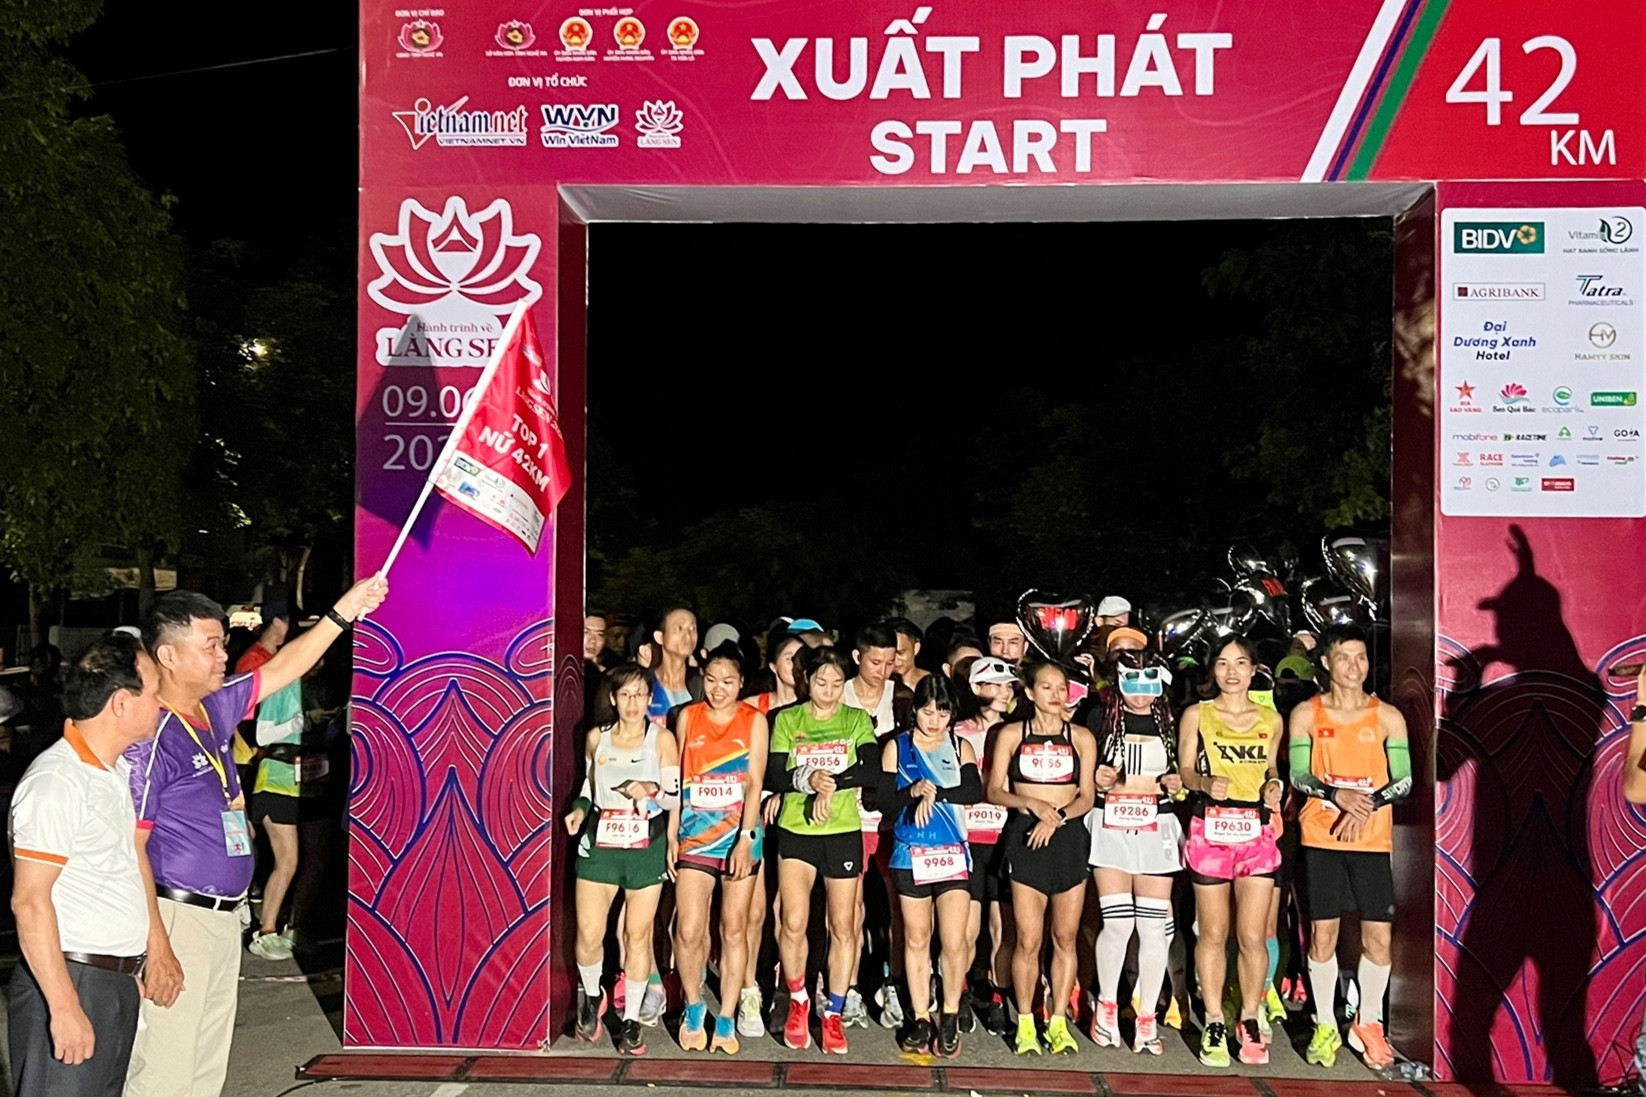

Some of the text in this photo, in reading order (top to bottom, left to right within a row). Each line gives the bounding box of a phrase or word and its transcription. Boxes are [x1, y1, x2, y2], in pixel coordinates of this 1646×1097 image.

[750, 7, 1233, 100] XUẤT PHÁT
[508, 76, 531, 87] ĐƠN
[532, 76, 543, 89] VỊ
[1446, 35, 1580, 126] 42
[869, 120, 1107, 175] START
[1550, 129, 1617, 166] KM
[1461, 229, 1518, 249] BIDV
[1576, 275, 1623, 297] Tatra
[1470, 288, 1540, 298] AGRIBANK
[416, 322, 447, 333] Hành
[1483, 320, 1507, 335] Đại
[386, 332, 500, 359] LÀNG SE
[1501, 336, 1537, 347] Xanh
[1475, 350, 1511, 361] Hotel
[1609, 353, 1631, 361] SKIN
[511, 413, 538, 446] TOP
[537, 443, 549, 459] 1
[1452, 433, 1498, 441] mobifone
[382, 434, 450, 471] 20
[511, 447, 551, 493] 42KM
[698, 787, 733, 797] F9014
[968, 810, 1002, 821] F9019
[1113, 806, 1149, 816] F9286
[606, 822, 640, 833] F966
[1214, 820, 1252, 832] F9630
[924, 856, 954, 868] 9968
